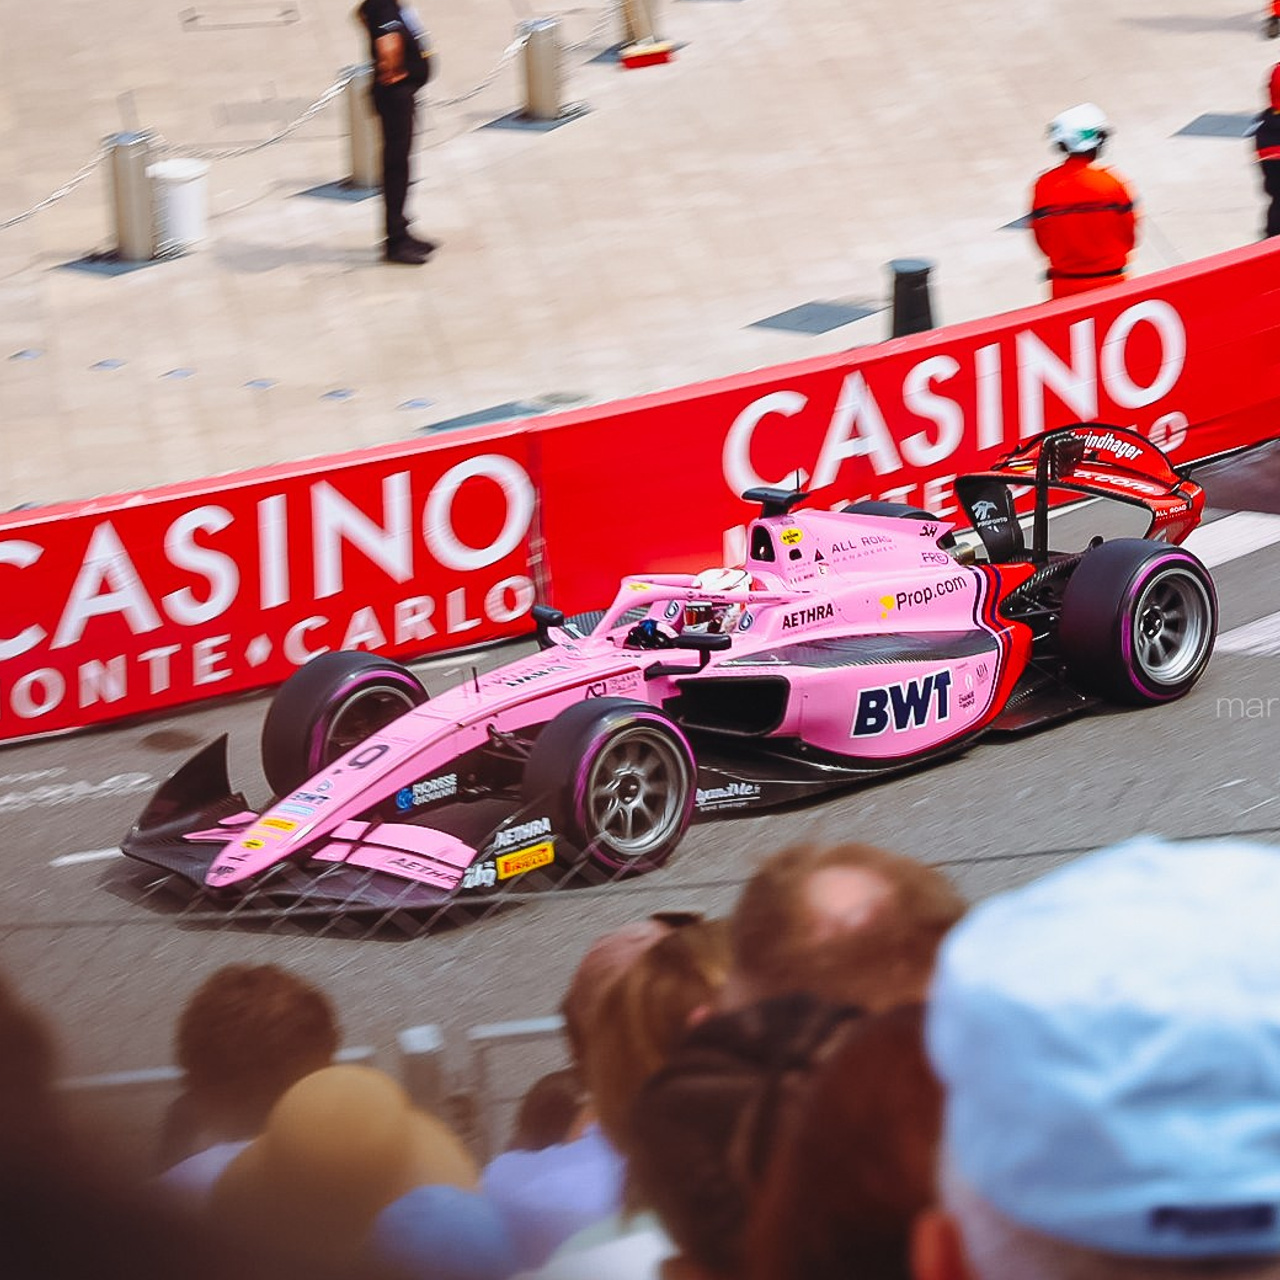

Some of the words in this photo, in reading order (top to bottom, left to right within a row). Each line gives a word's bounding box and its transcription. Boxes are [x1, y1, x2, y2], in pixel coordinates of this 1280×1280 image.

[722, 299, 1187, 504] CASINO
[1072, 431, 1144, 461] indhager
[831, 539, 857, 555] ALL
[896, 576, 967, 610] Prop.com
[781, 603, 834, 630] AETHRA
[9, 633, 233, 719] ONTE
[283, 575, 536, 665] CARLO
[853, 670, 951, 737] BWT
